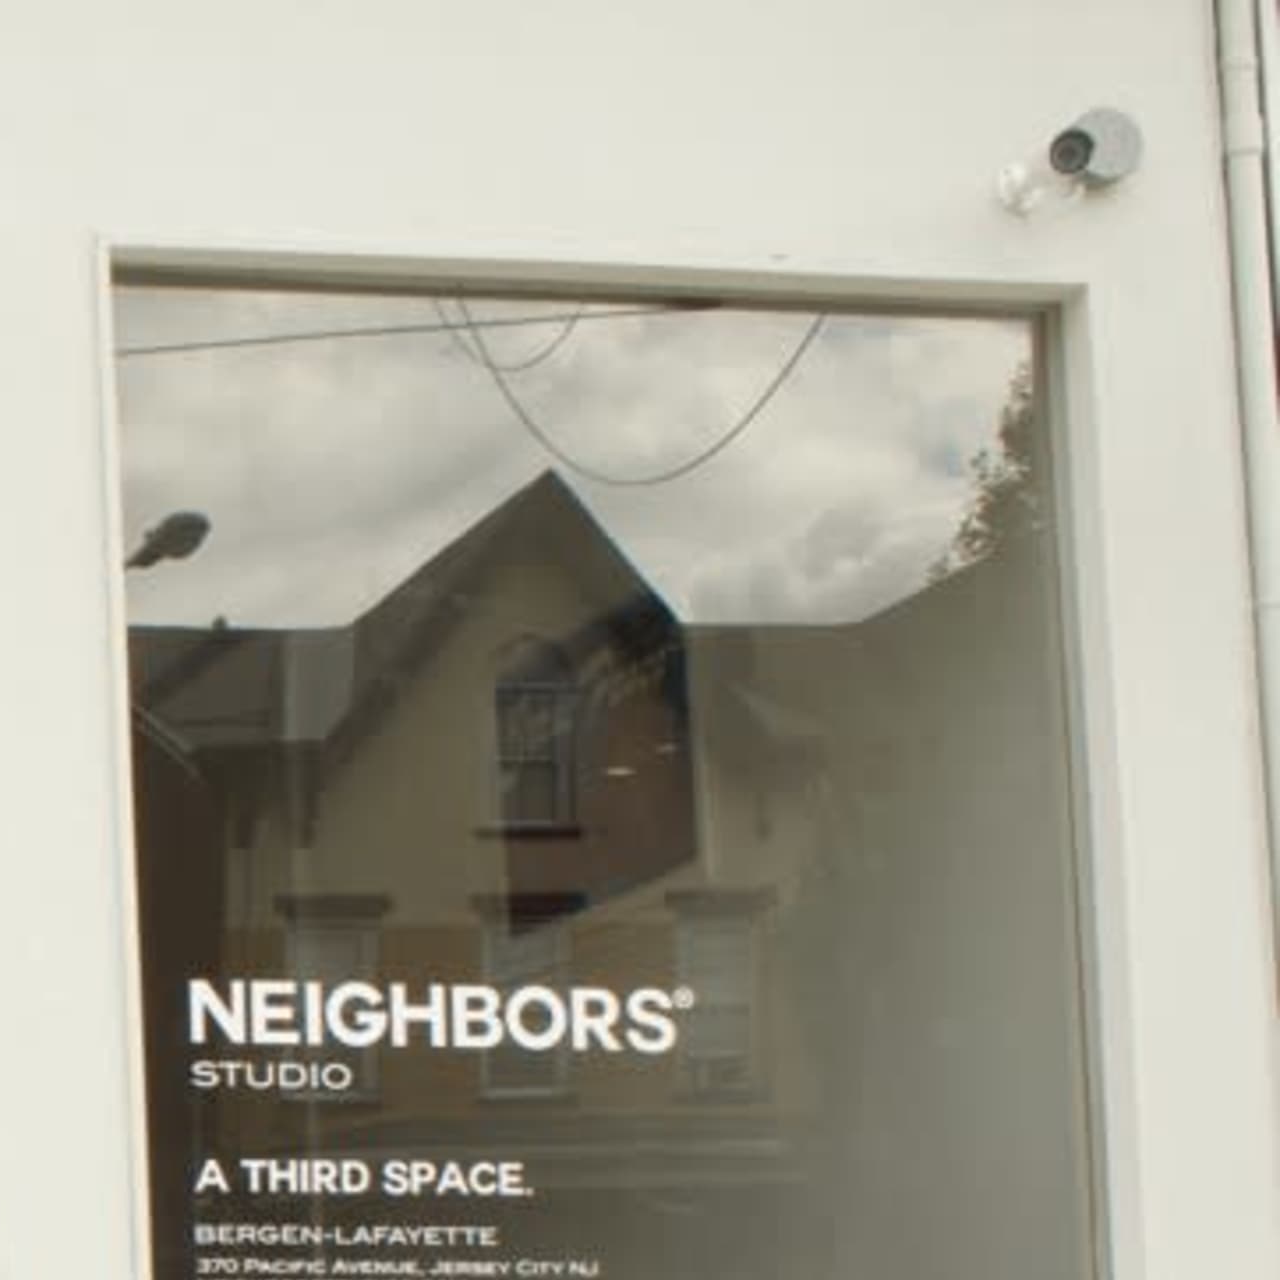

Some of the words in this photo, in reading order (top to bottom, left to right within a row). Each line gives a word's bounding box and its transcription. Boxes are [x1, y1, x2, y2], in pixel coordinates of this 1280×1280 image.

[190, 1060, 353, 1091] STUDIO
[194, 1159, 230, 1193] A
[241, 1160, 370, 1194] THIRD
[383, 1161, 534, 1197] SPACE.
[194, 1225, 498, 1246] BERGEN-LAFAYETTE
[197, 1257, 238, 1274] 370
[568, 1260, 600, 1278] NJ
